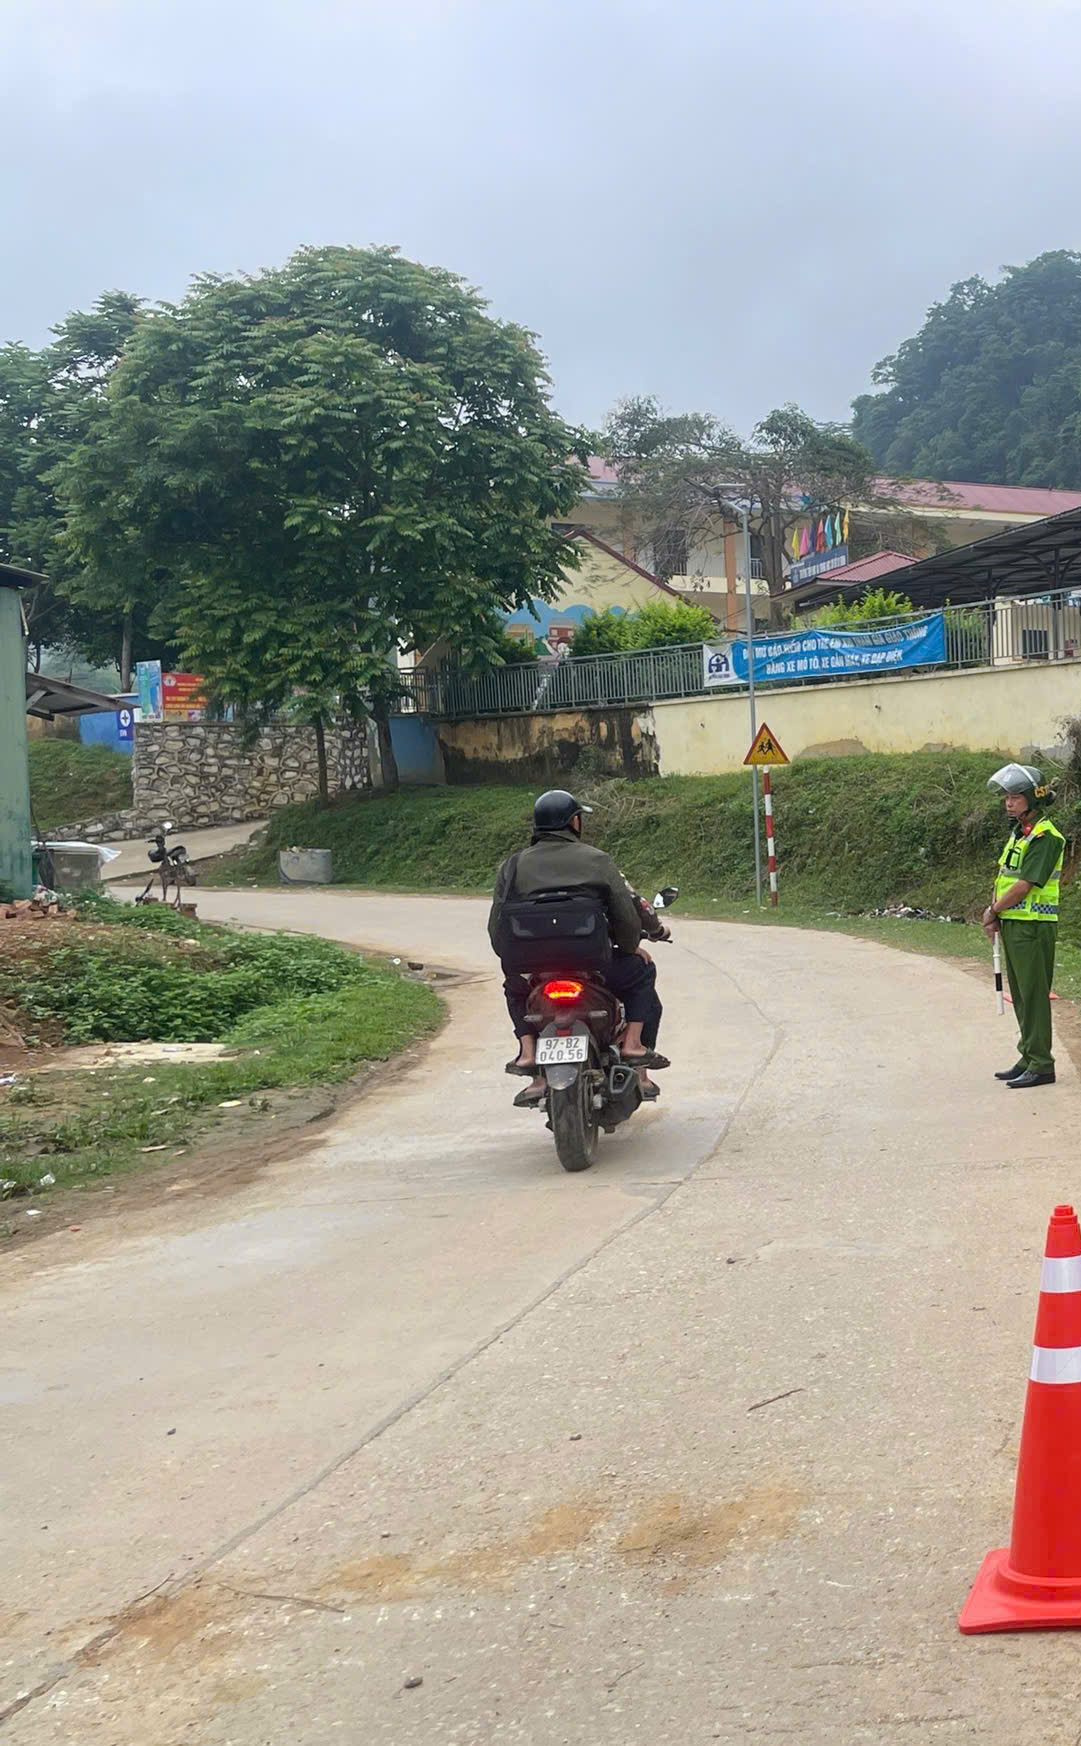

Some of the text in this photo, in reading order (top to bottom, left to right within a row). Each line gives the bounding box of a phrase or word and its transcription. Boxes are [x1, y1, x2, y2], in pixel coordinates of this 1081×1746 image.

[802, 639, 817, 652] CHO
[786, 660, 796, 673] XE
[821, 656, 830, 668] XE
[545, 1038, 580, 1049] 97-B2
[540, 1048, 583, 1061] 040.56
